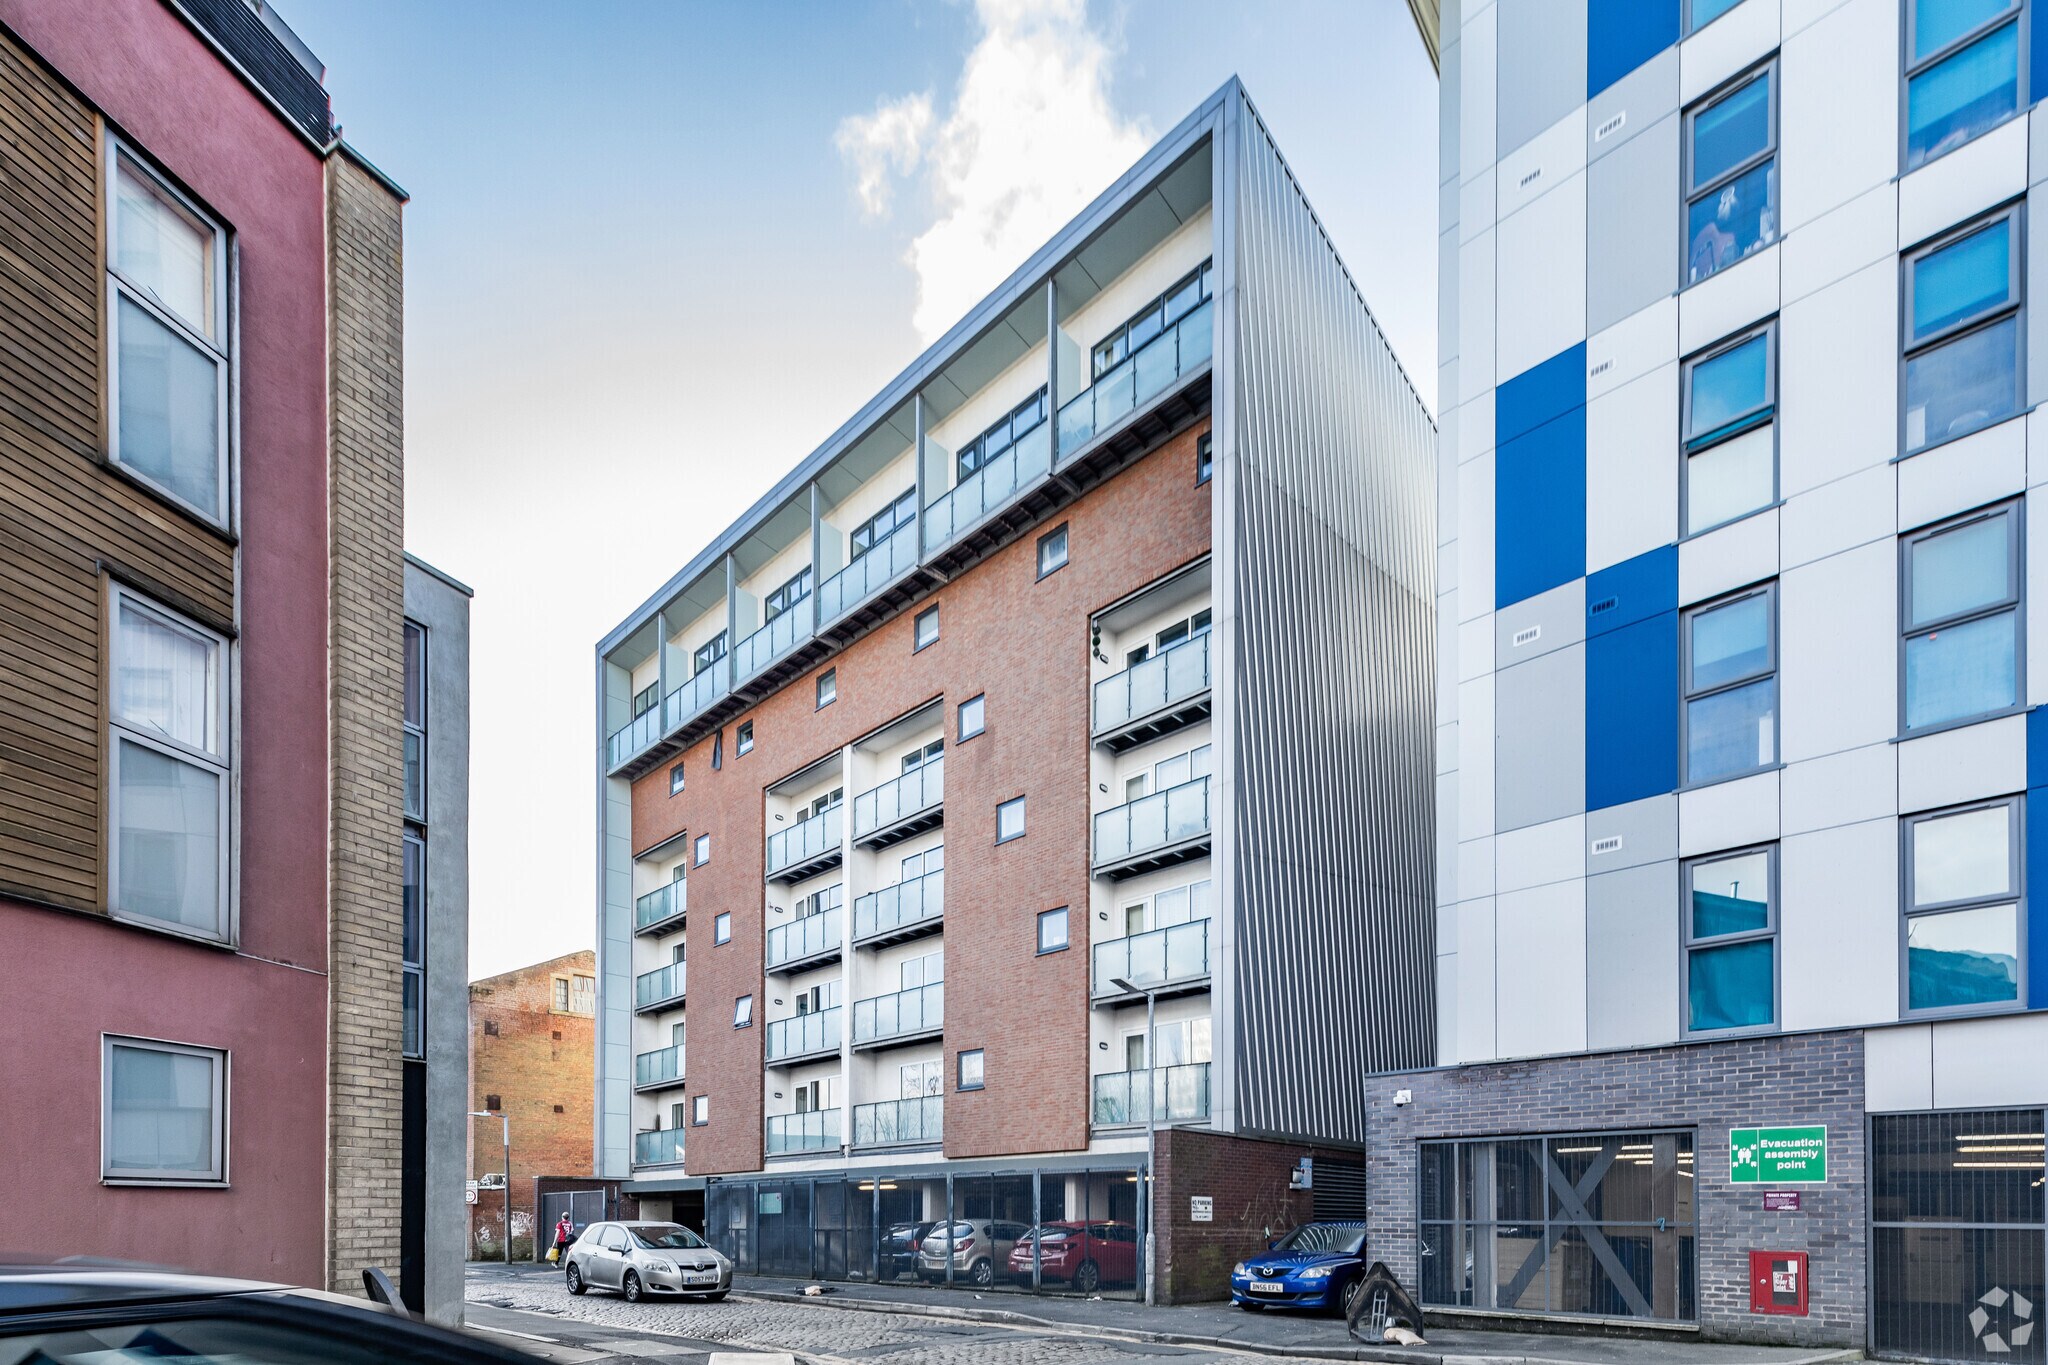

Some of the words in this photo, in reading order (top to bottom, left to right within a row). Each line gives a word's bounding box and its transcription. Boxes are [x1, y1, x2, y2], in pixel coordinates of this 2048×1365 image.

[1760, 1138, 1822, 1148] Evacuation
[1765, 1149, 1818, 1159] assembly
[1777, 1160, 1806, 1171] point
